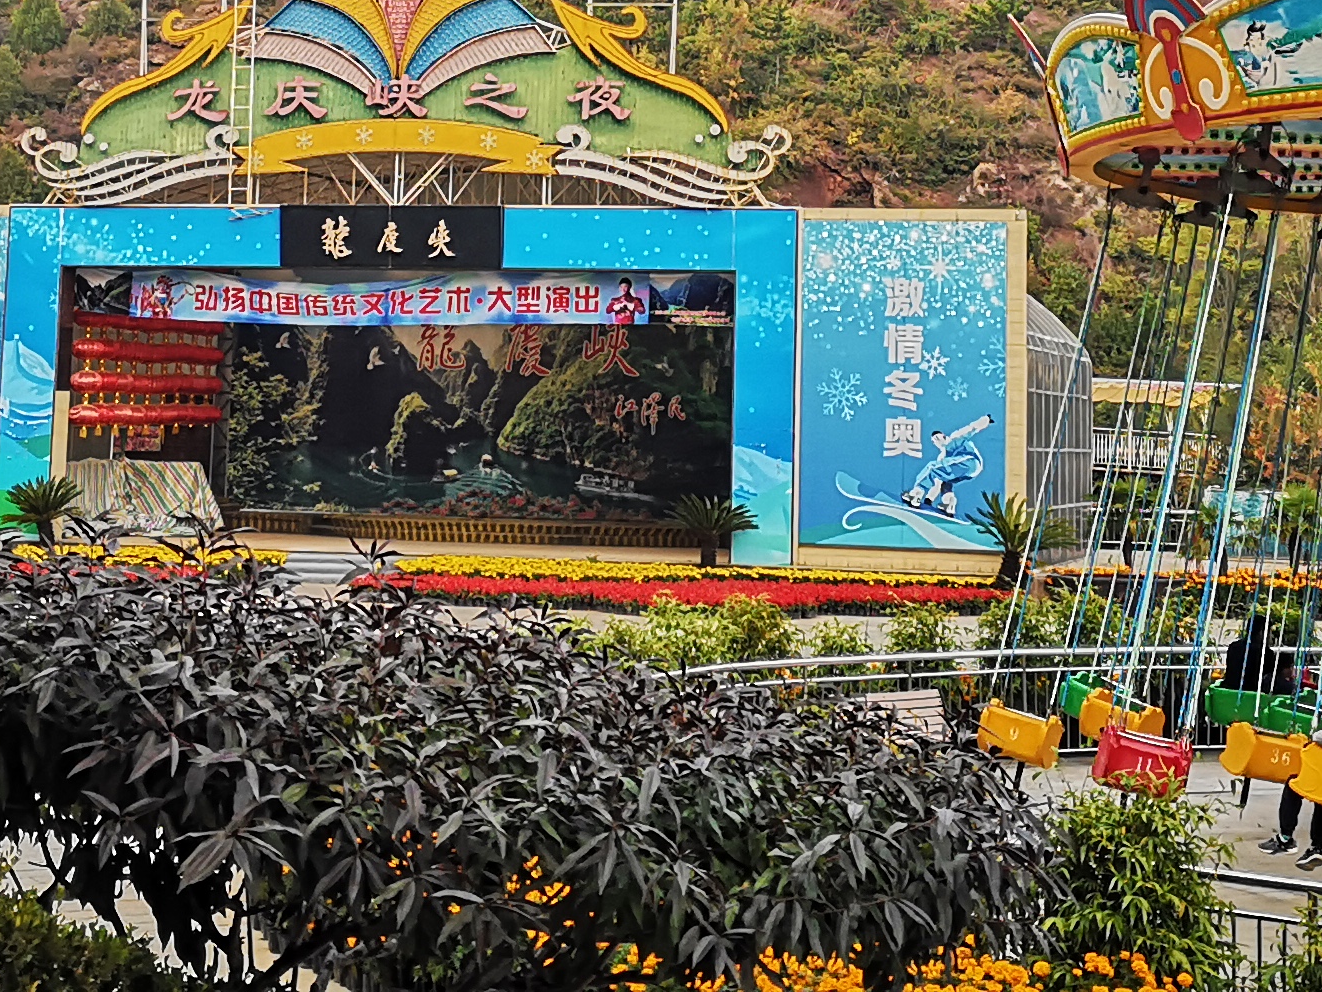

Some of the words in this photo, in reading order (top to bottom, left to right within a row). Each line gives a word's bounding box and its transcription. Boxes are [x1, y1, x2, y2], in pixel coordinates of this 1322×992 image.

[166, 73, 633, 122] 龙庆峡之夜
[192, 284, 601, 317] 弘扬中国传统文化艺术·大型演出
[882, 277, 925, 459] 激情冬奥
[1270, 747, 1292, 766] 36
